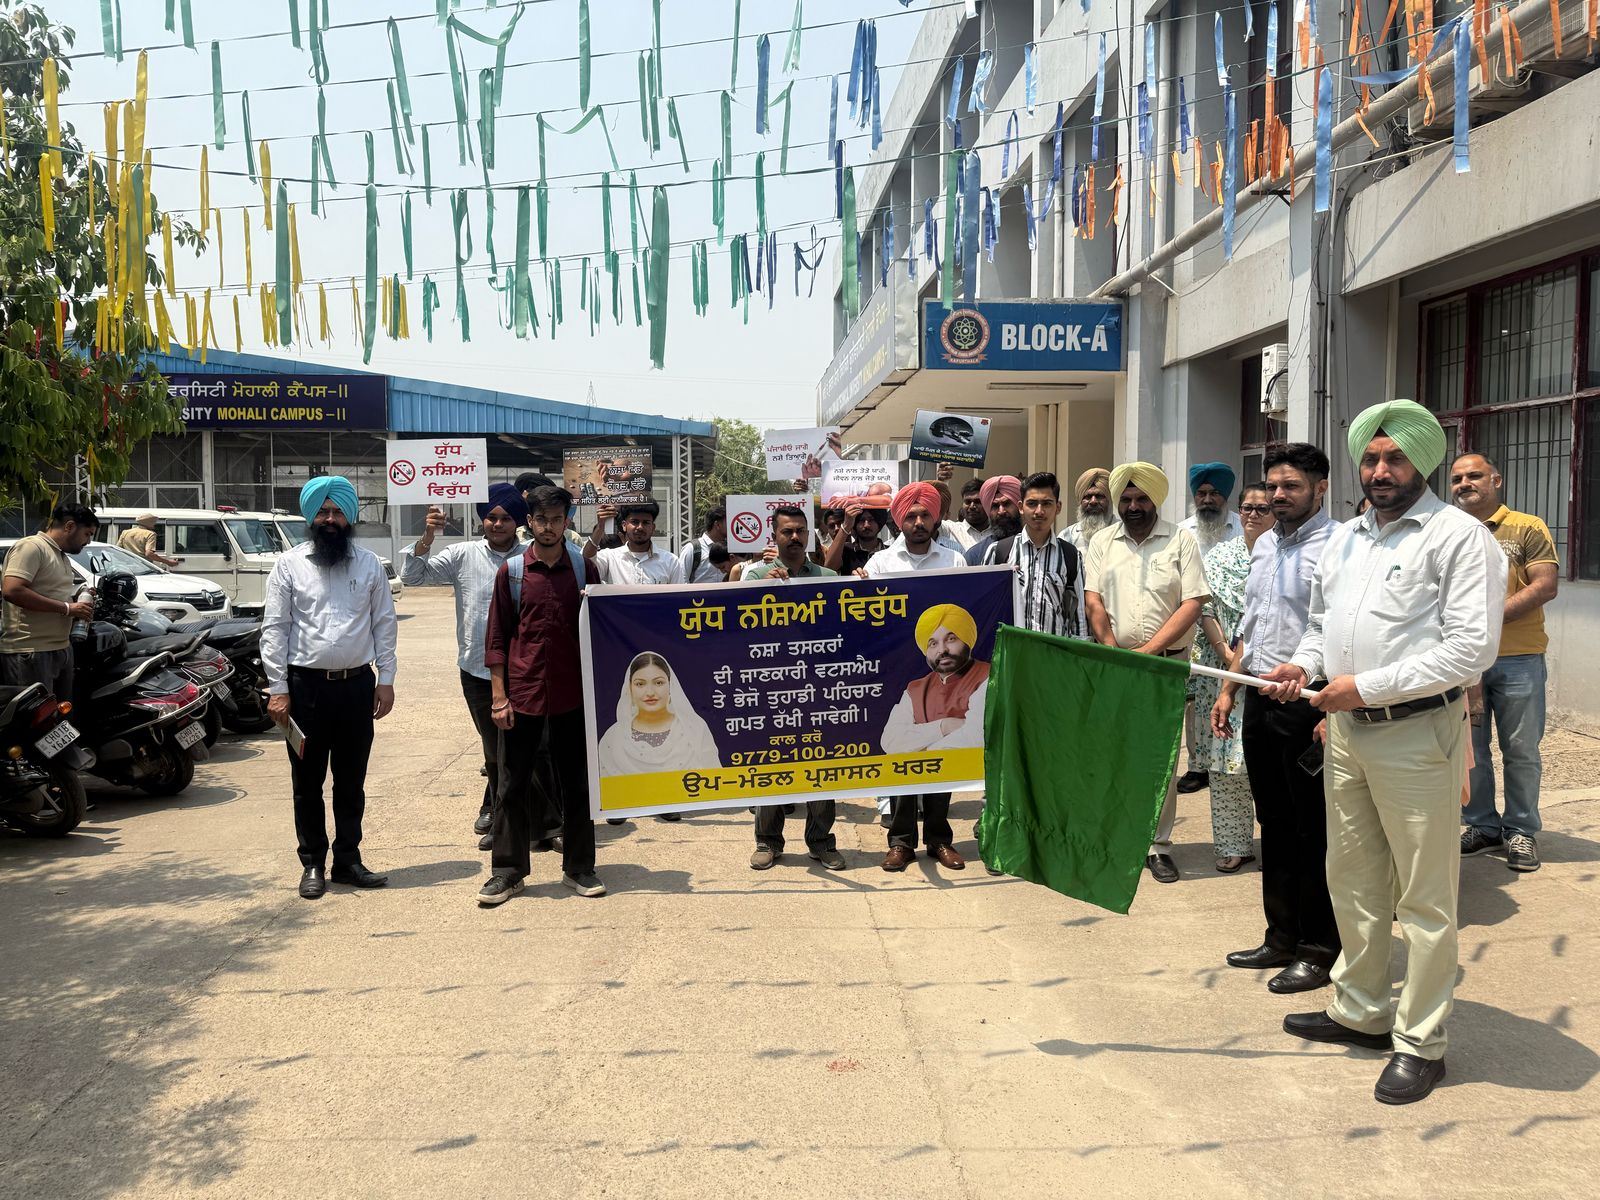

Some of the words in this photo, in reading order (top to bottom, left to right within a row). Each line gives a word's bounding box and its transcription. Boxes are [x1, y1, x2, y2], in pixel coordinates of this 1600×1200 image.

[1001, 323, 1108, 351] BLOCK-A
[167, 381, 227, 397] ਵਰਸਿਟੀ
[232, 380, 280, 397] ਮੋਹਾਲੀ
[217, 407, 267, 420] MOHALI
[270, 407, 323, 420] CAMPUS
[434, 442, 462, 458] ਯੁੱਧ
[421, 462, 476, 476] ਨਸ਼ਿਆਂ
[427, 481, 471, 498] ਵਿਰੁੱਧ
[678, 598, 726, 639] ਯੁੱਧ
[737, 592, 827, 629] ਨਸ਼ਿਆਂ
[837, 586, 909, 626] ਵਿਰੁੱਧ
[749, 642, 781, 659] ਨਸ਼ਾ
[787, 634, 843, 656] ਤਸਕਰਾਂ
[713, 665, 733, 685] ਦੀ
[740, 659, 808, 683] ਜਾਣਕਾਰੀ
[814, 654, 880, 678] ਵਟਸਐਪ
[712, 689, 726, 708] ਤੇ
[734, 687, 760, 708] ਭੇਜੋ
[767, 683, 816, 709] ਤੁਹਾਡੀ
[823, 681, 883, 701] ਪਹਿਚਾਣ
[725, 714, 766, 736] ਗੁਪਤ
[773, 707, 803, 729] ਰੱਖੀ
[769, 735, 796, 746] ਕਾਲ
[801, 732, 822, 744] ਕਰੋ
[730, 742, 871, 766] 9779-100-200
[804, 763, 883, 788] ਪ੍ਰਸ਼ਾਸਨ
[892, 757, 944, 776] ਖਰੜ
